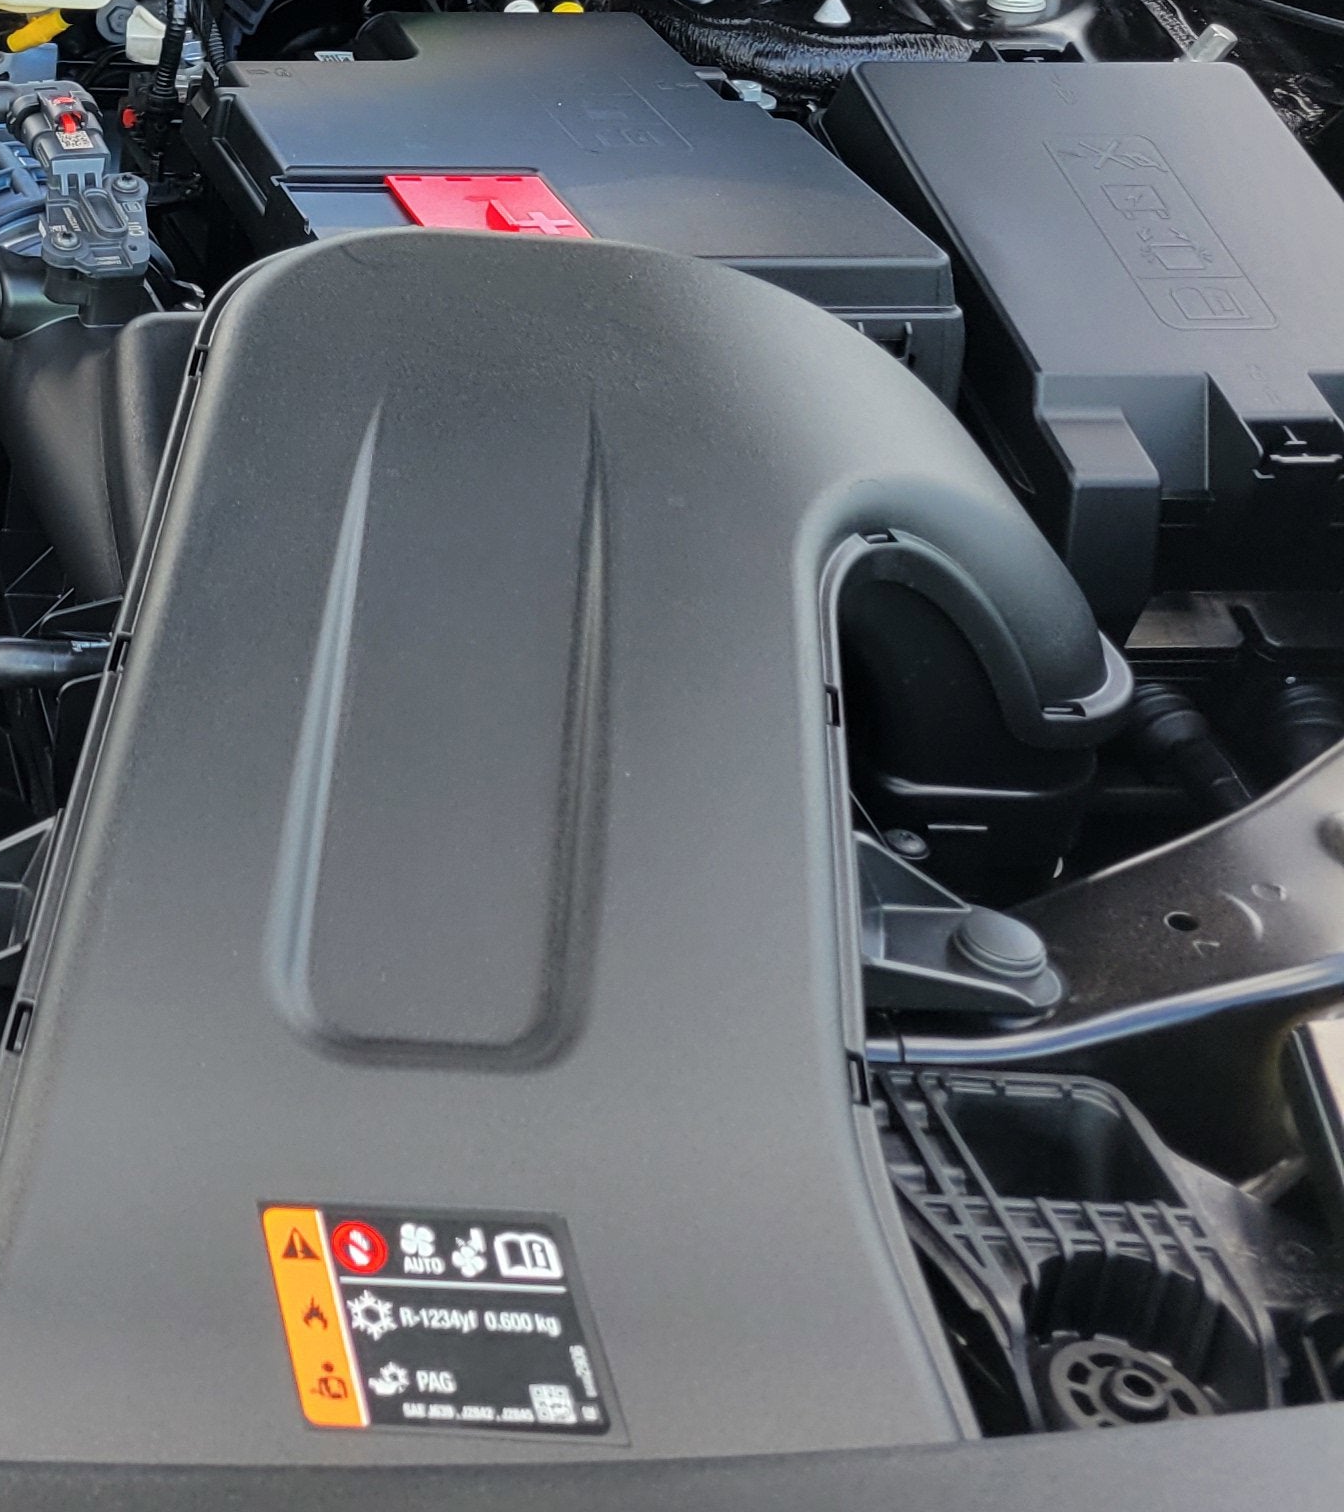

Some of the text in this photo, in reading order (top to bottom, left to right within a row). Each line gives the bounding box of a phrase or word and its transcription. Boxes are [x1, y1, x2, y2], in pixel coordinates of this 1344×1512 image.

[404, 1256, 445, 1275] AUTO
[399, 1306, 562, 1338] R-1234yf 0.600 kg
[416, 1370, 457, 1394] PAG
